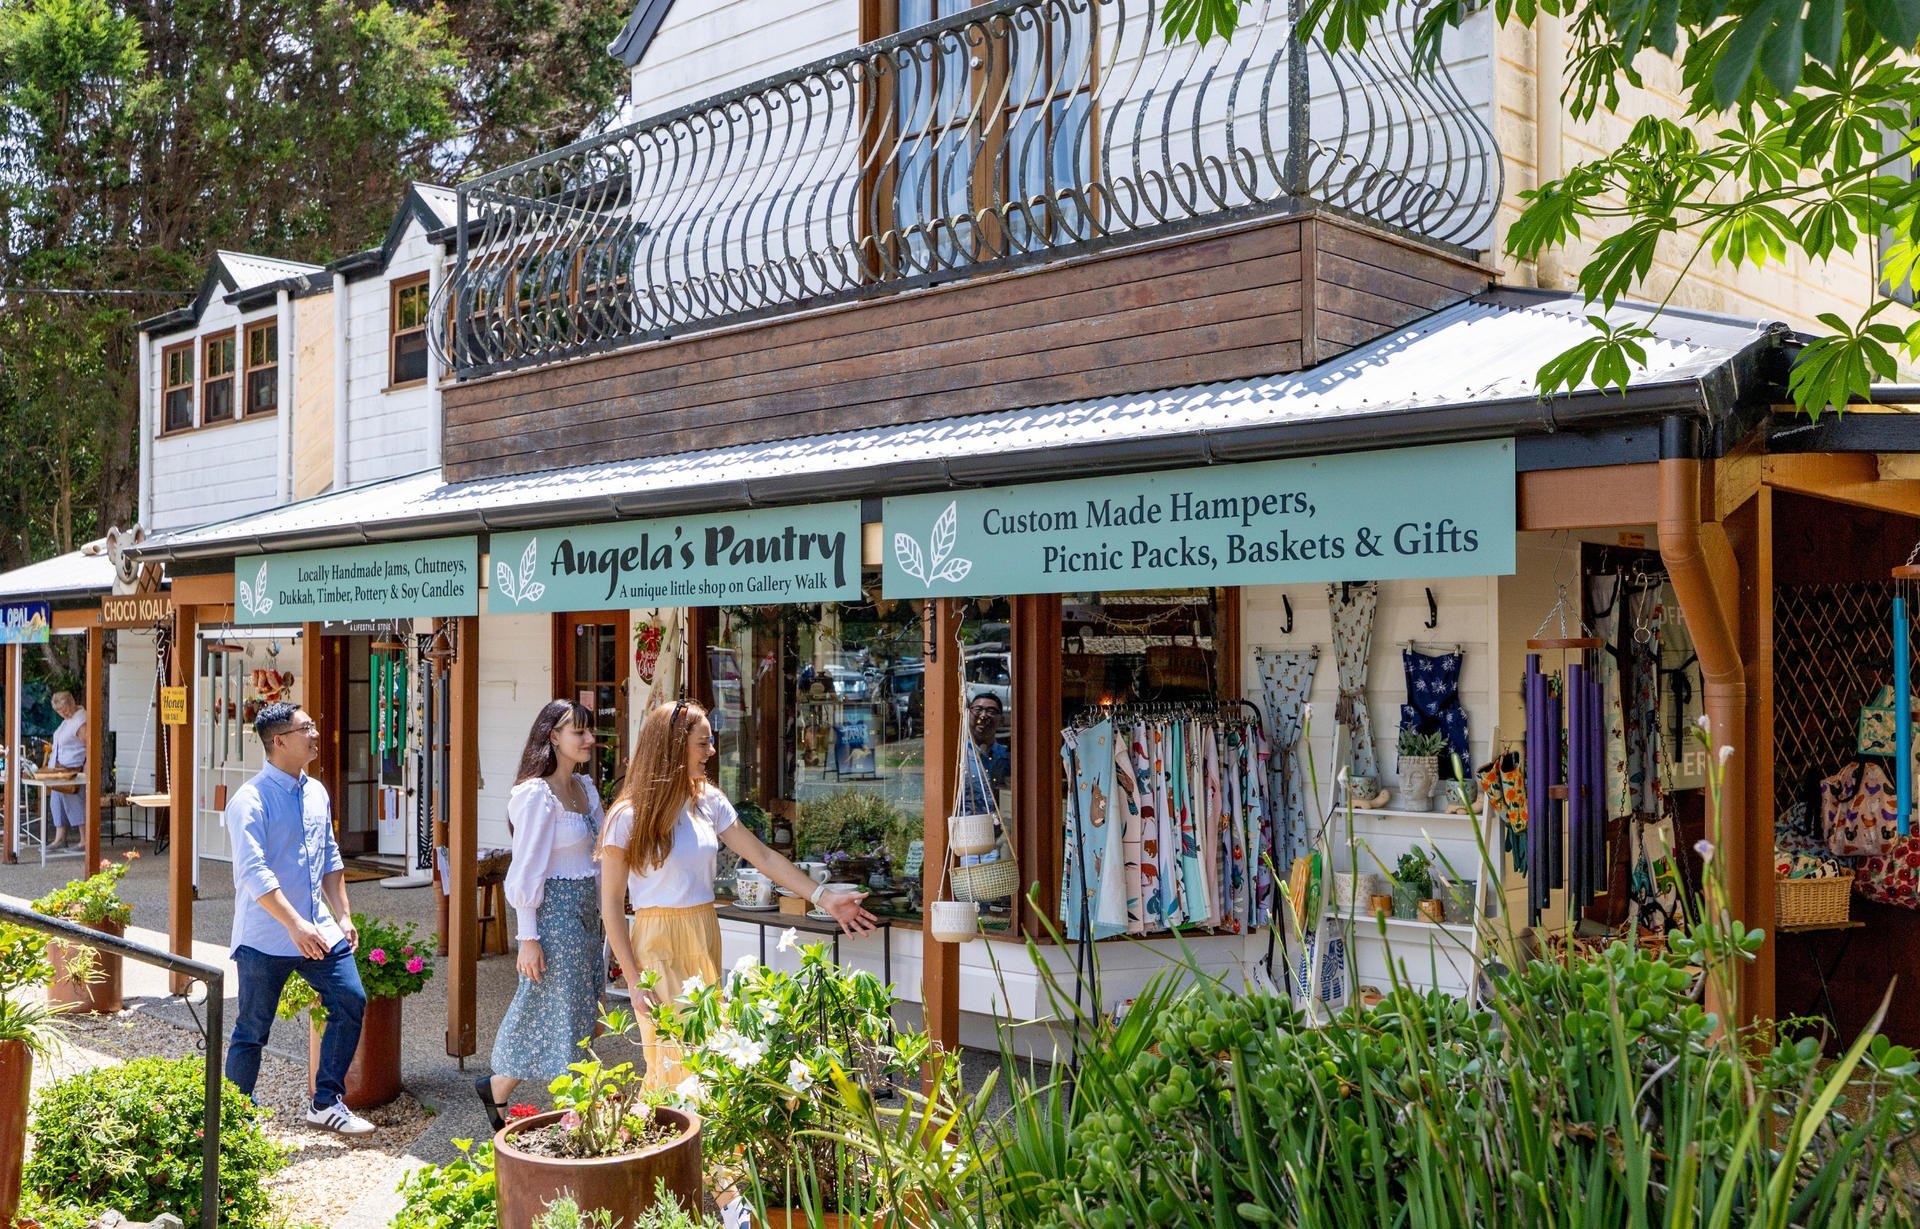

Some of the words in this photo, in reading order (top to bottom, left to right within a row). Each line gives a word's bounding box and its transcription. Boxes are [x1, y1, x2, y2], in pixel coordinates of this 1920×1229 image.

[982, 508, 1079, 536] Custom
[1086, 496, 1162, 529] Made
[1170, 490, 1317, 527] Hampers,
[1042, 543, 1123, 574] Picnic
[1130, 536, 1219, 570] Packs,
[1226, 526, 1345, 565] Baskets
[1354, 527, 1383, 557] &
[1393, 518, 1479, 556] Gifts
[298, 563, 329, 585] Locally
[332, 561, 382, 580] Handmade
[384, 560, 410, 579] Jams,
[414, 557, 467, 577] Chutneys,
[551, 526, 695, 601] Angela's
[704, 525, 846, 588] Pantry
[279, 587, 316, 607] Dukkah,
[317, 586, 353, 604] Timber,
[355, 585, 388, 604] Pottery
[390, 584, 399, 599] &
[401, 583, 419, 602] Soy
[421, 580, 464, 598] Candles
[619, 584, 628, 599] A
[630, 582, 668, 601] unique
[670, 579, 696, 596] little
[698, 578, 727, 598] shop
[728, 580, 744, 594] on
[747, 575, 792, 596] Gallery
[795, 573, 828, 591] Walk
[7, 607, 30, 628] OPAL
[104, 600, 136, 622] CHOCO
[139, 598, 173, 621] KOALA
[354, 623, 375, 631] LIFESTYLE
[163, 696, 184, 712] Honey
